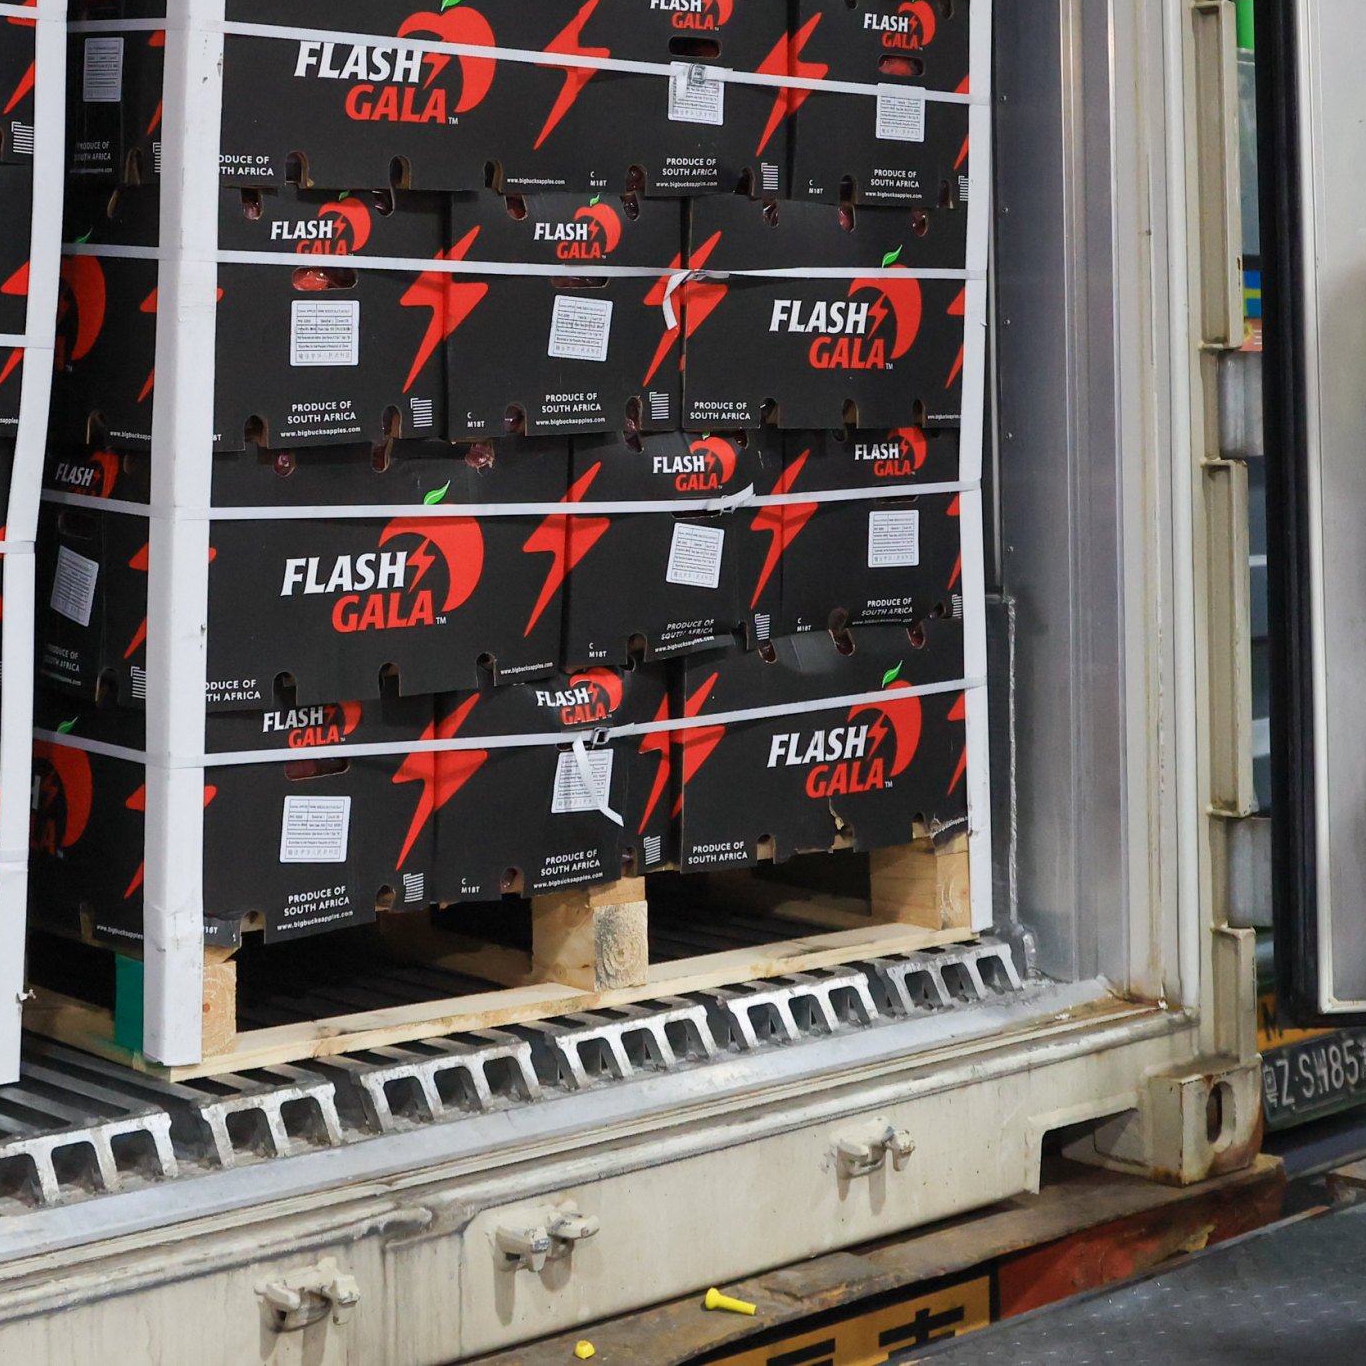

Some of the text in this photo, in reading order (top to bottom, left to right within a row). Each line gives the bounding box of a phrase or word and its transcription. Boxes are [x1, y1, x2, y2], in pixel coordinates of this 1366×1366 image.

[672, 12, 714, 30] GALA
[864, 13, 908, 32] FLASH
[882, 32, 918, 49] GALA
[294, 40, 424, 83] FLASH
[345, 85, 446, 124] GALA
[271, 220, 333, 240] FLASH
[534, 223, 587, 241] FLASH
[556, 241, 601, 259] GALA
[769, 300, 870, 333] FLASH
[809, 337, 885, 369] GALA
[292, 401, 352, 412] PRODUCE OF
[287, 412, 356, 424] SOUTH AFRICA
[855, 443, 899, 461] FLASH
[653, 455, 705, 473] FLASH
[874, 460, 911, 476] GALA
[54, 462, 94, 486] FLASH
[676, 473, 718, 490] GALA
[280, 551, 407, 596] FLASH
[332, 591, 433, 632] GALA
[536, 688, 589, 707] FLASH
[263, 706, 324, 733] FLASH
[561, 704, 606, 725] GALA
[288, 724, 339, 748] GALA
[767, 725, 868, 768] FLASH
[805, 758, 884, 799] GALA
[693, 841, 745, 853] PRODUCE OF
[688, 852, 748, 863] SOUTH AFRICA
